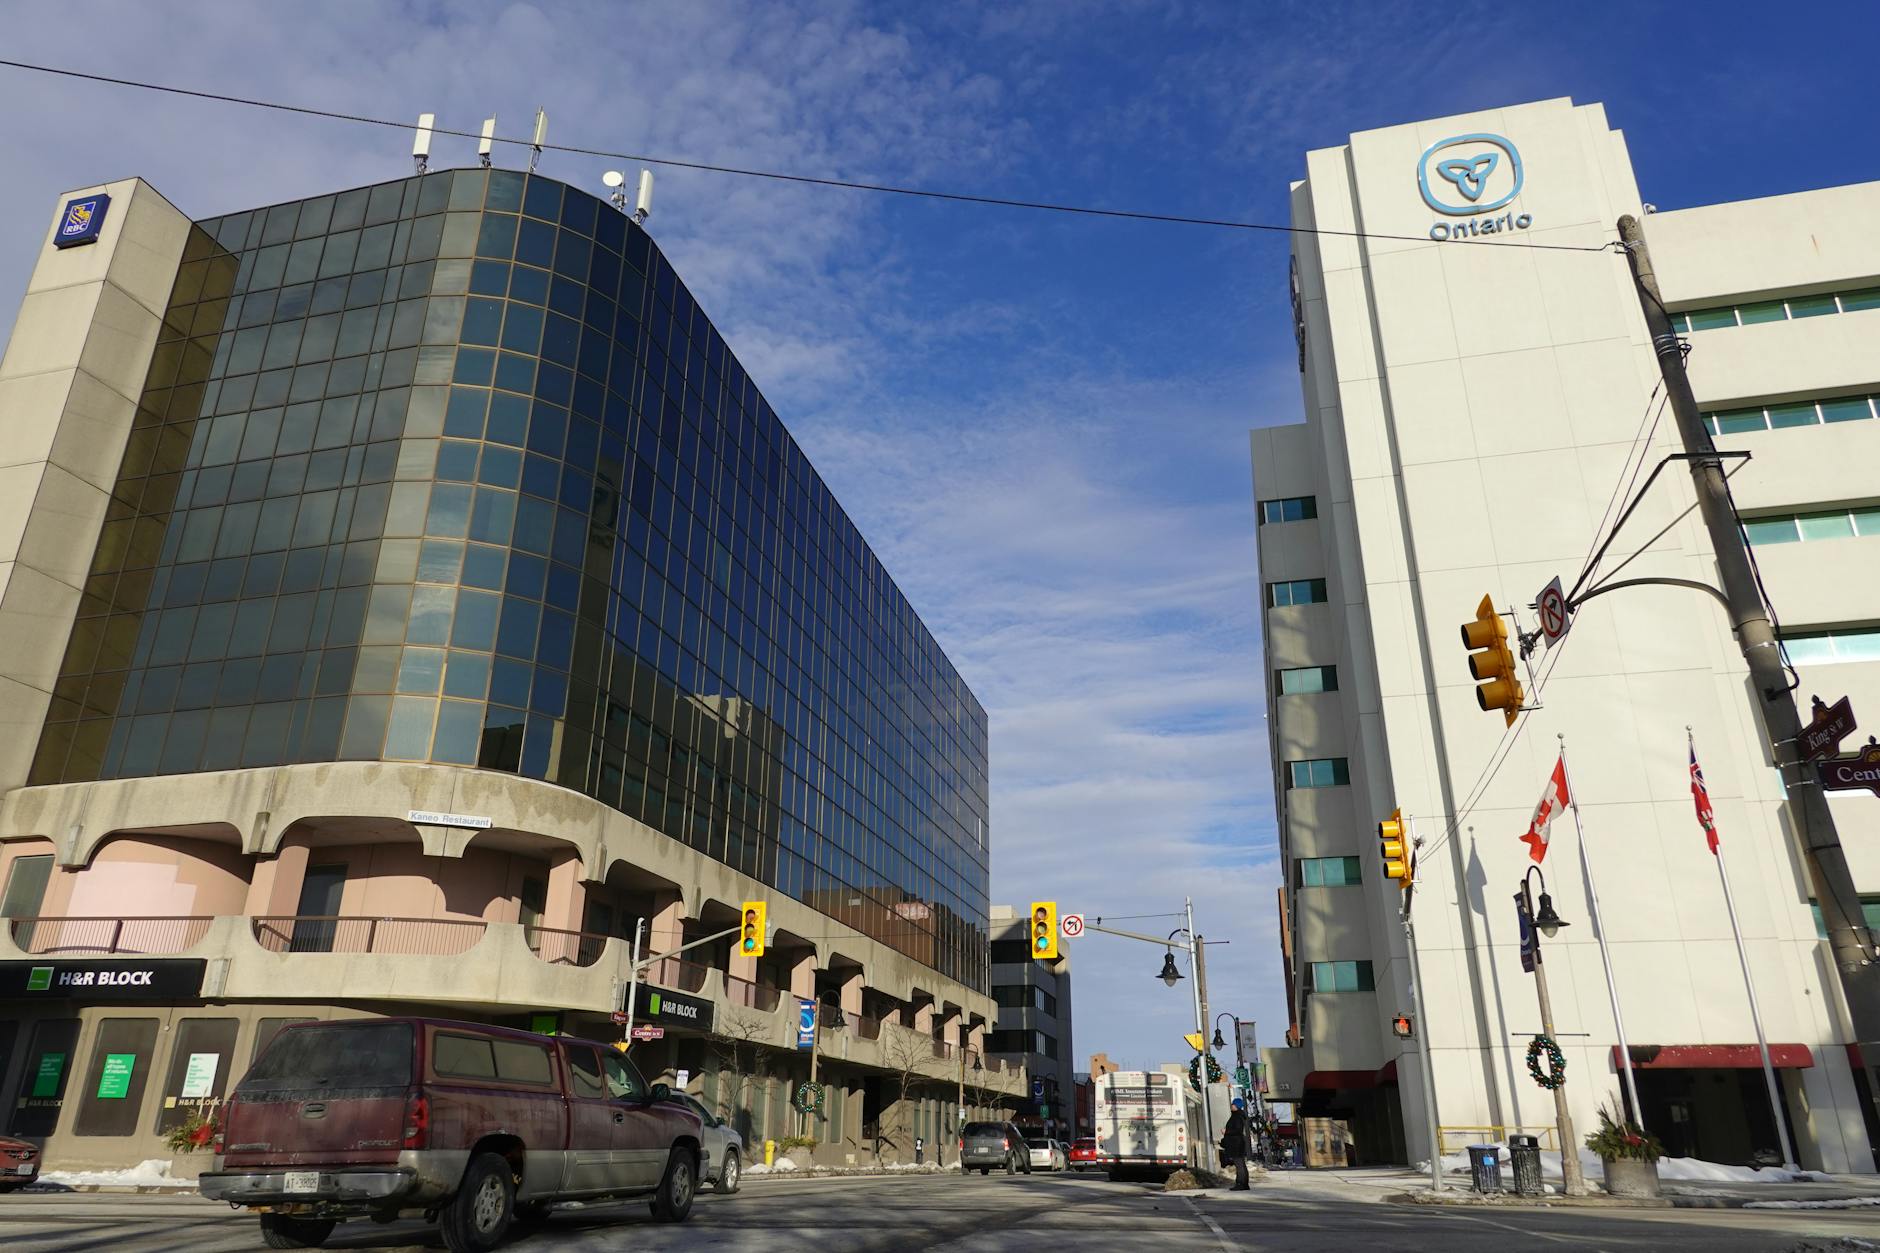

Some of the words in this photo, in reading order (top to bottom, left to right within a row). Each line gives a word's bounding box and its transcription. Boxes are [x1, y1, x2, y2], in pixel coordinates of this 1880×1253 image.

[66, 222, 87, 233] RBC
[1430, 212, 1533, 241] Ontario
[1808, 729, 1831, 751] King
[410, 812, 439, 823] Kaneo
[442, 815, 489, 826] Restaurant
[59, 972, 95, 986] H&R
[97, 971, 154, 986] BLOCK
[662, 1000, 677, 1014] H&R
[677, 1004, 698, 1019] BLOCK
